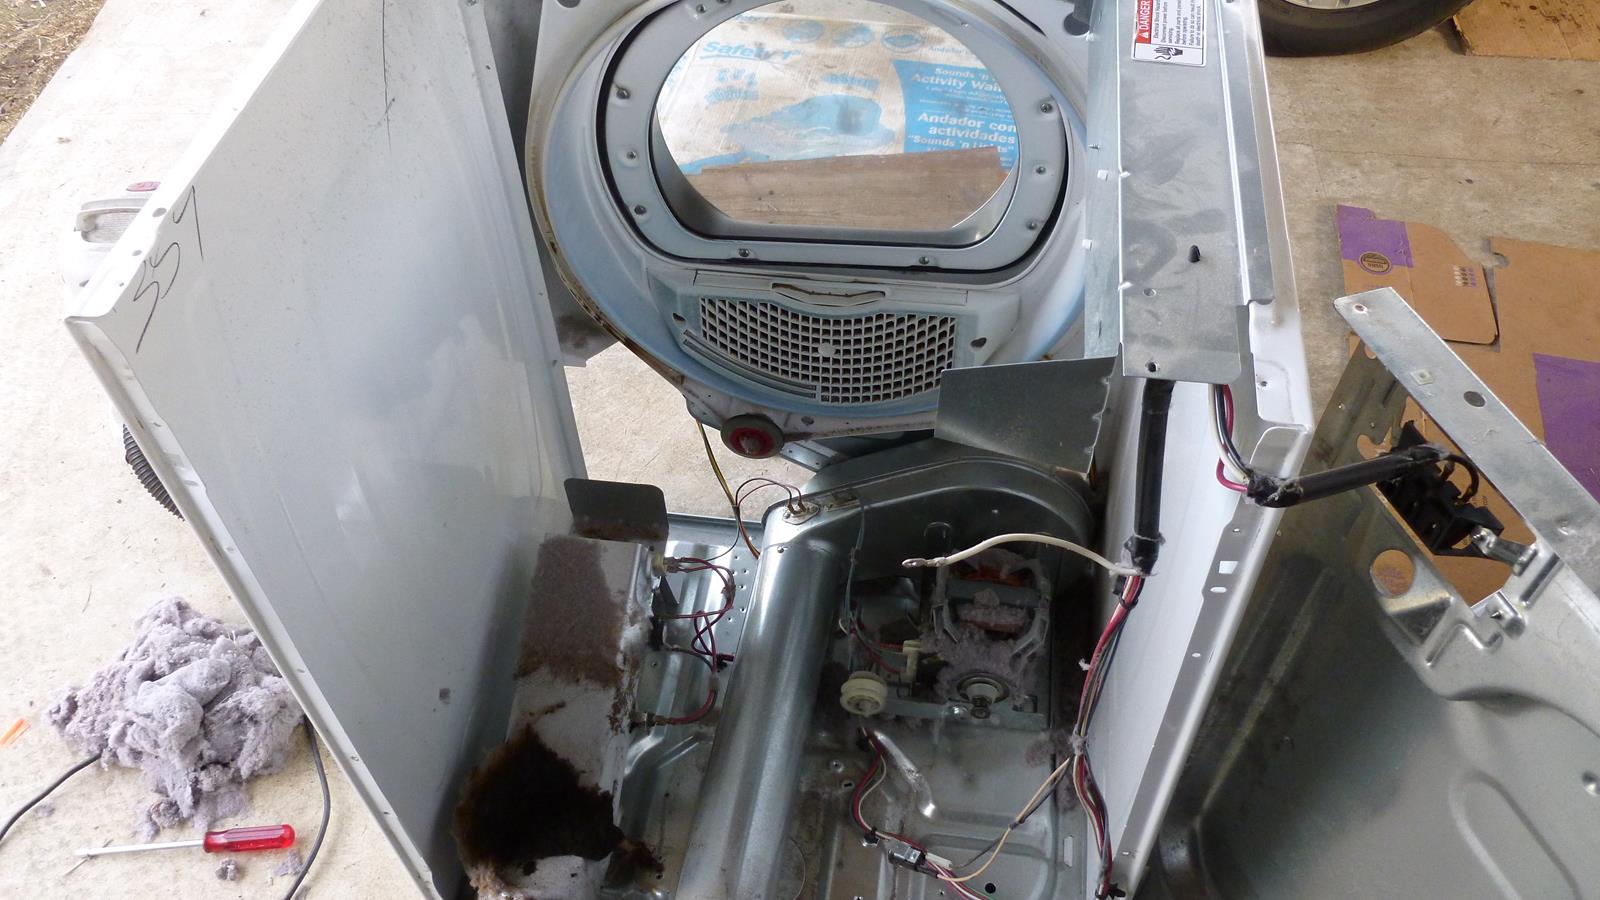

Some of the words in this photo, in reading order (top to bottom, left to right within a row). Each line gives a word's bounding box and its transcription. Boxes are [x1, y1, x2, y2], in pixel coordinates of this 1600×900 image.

[1139, 0, 1150, 30] DANGER
[912, 73, 966, 89] Activity
[934, 67, 975, 78] Sounds
[918, 112, 984, 129] Andador
[989, 122, 1017, 133] con
[928, 125, 1016, 144] actividades
